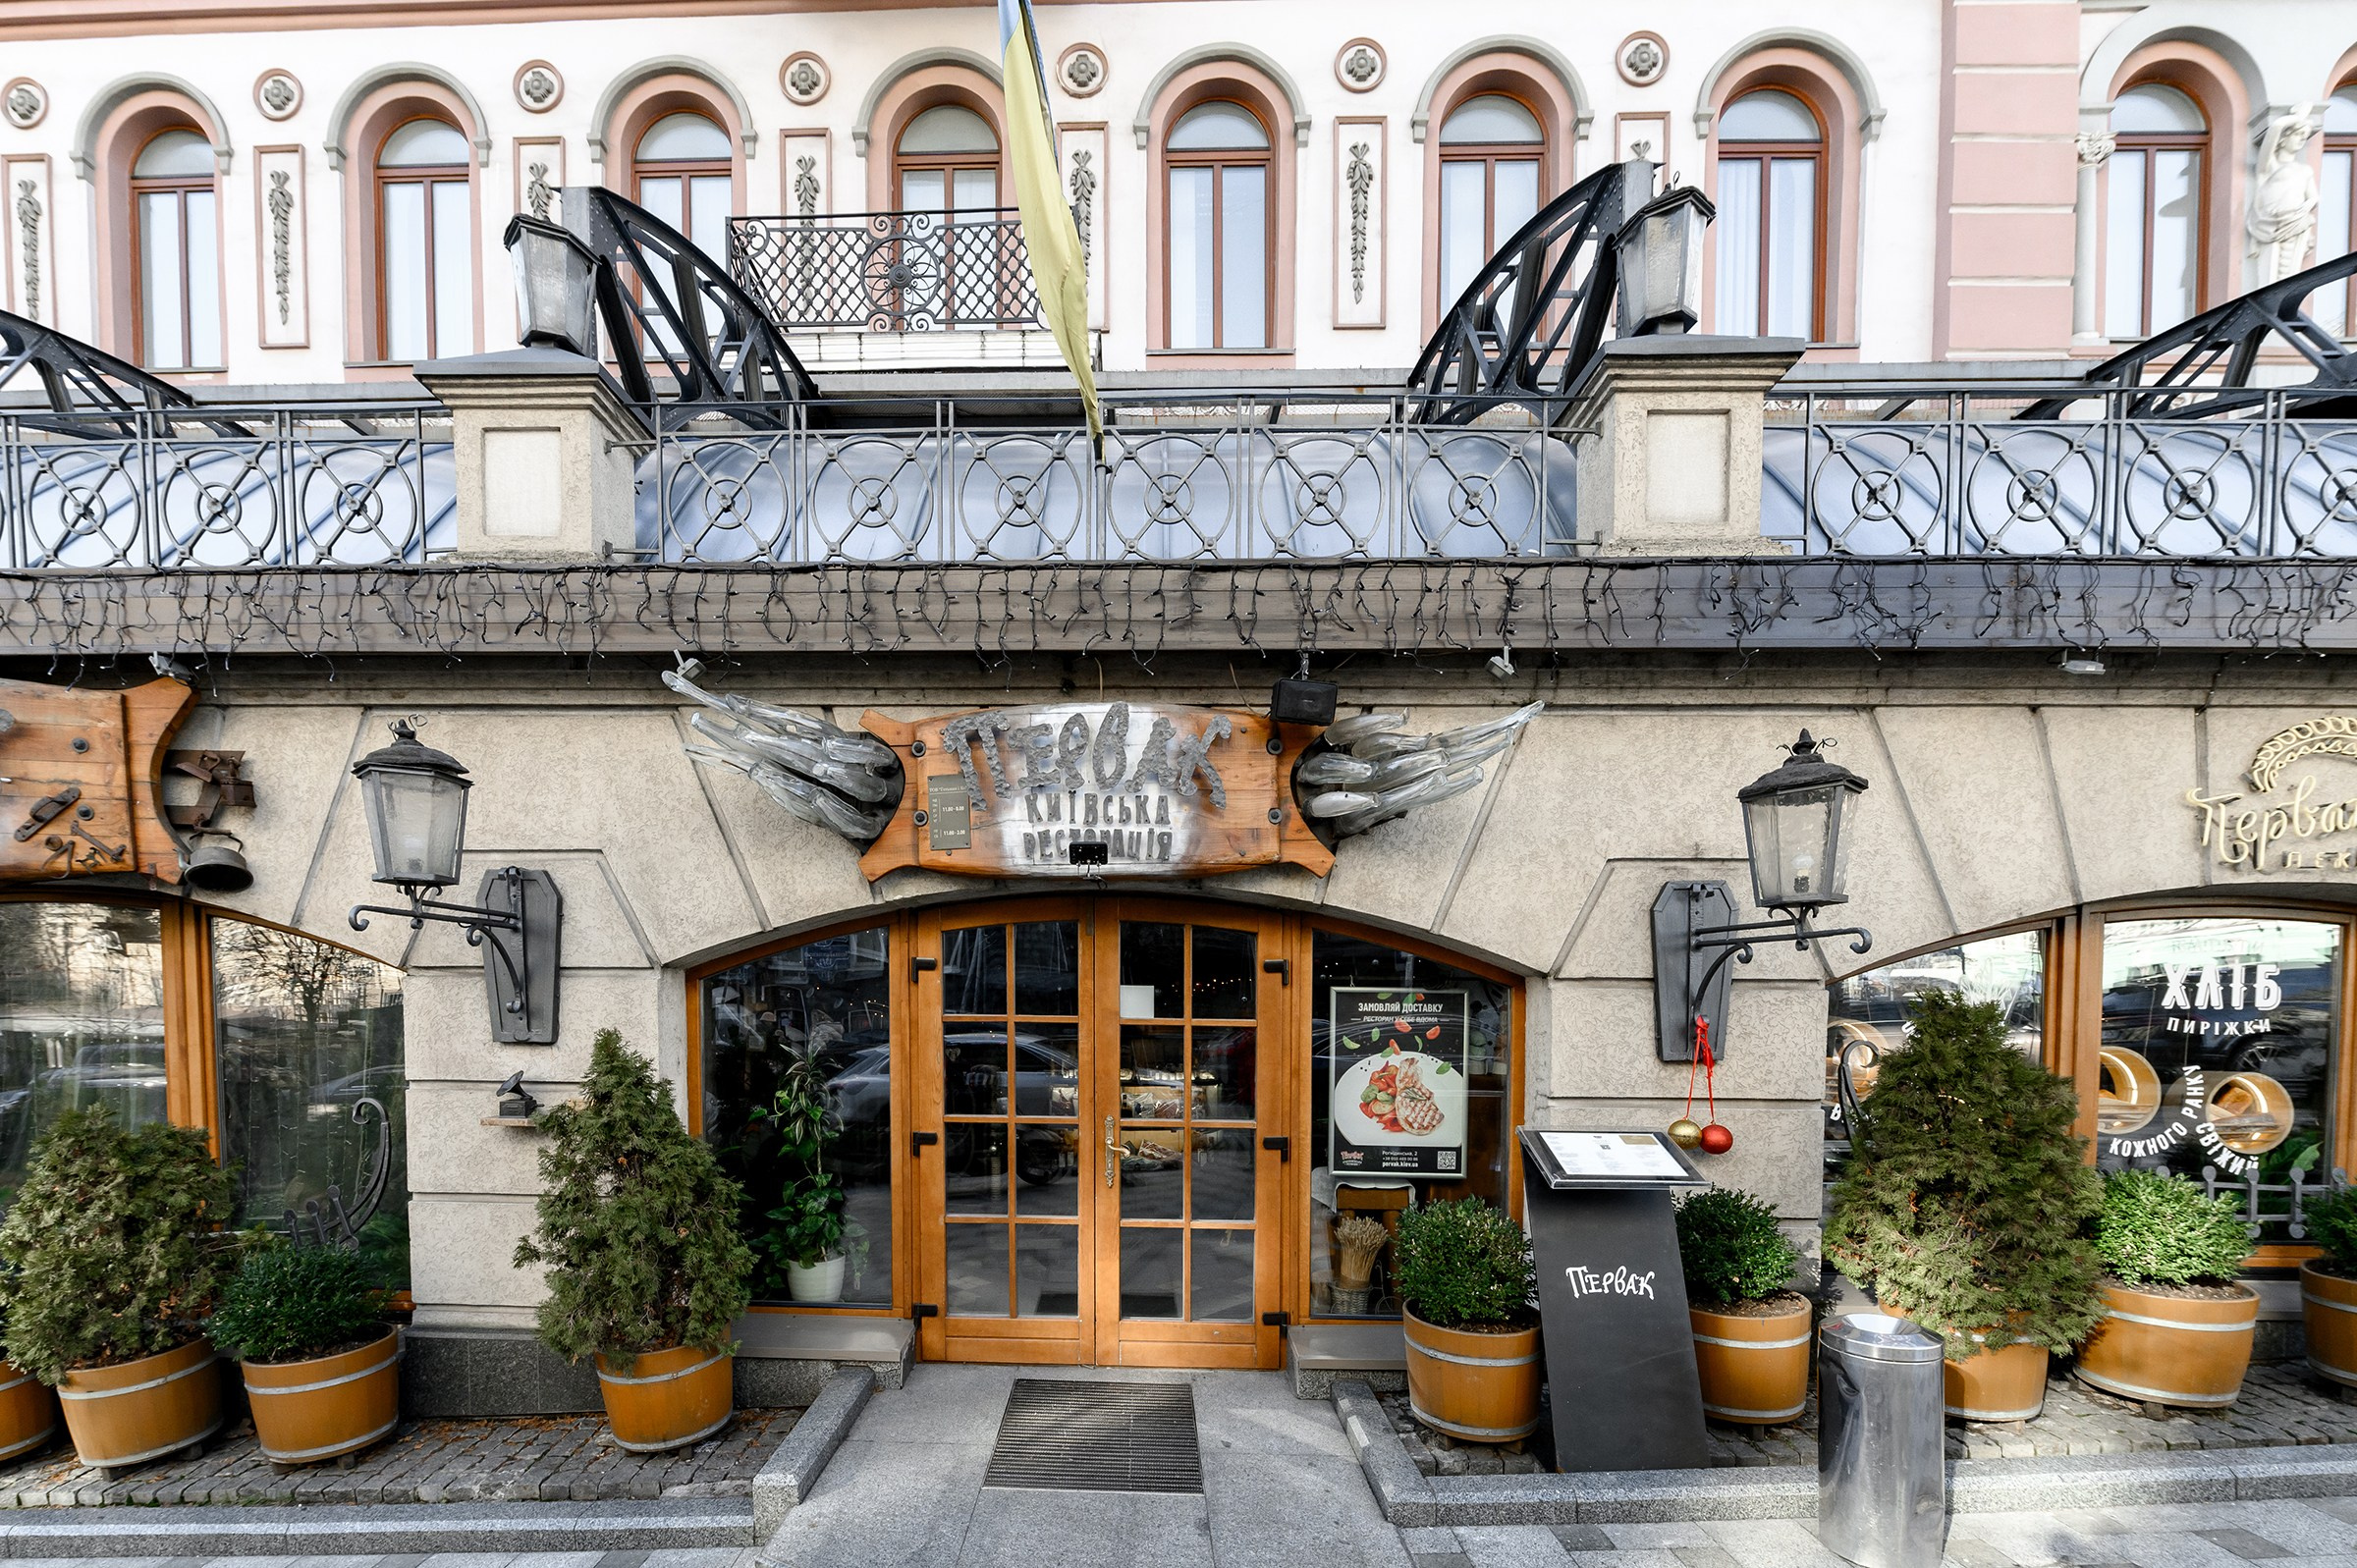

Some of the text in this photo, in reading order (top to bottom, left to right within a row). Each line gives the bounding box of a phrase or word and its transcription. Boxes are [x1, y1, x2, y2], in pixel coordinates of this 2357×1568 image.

[1024, 790, 1171, 825] КИЇВСЬКА
[2161, 962, 2282, 1010] ХЛІБ
[1358, 1001, 1444, 1013] ЗАМОВЛЯЙ ДОСТАВКУ
[2166, 1017, 2271, 1036] ПИРІЖКИ
[2109, 1064, 2205, 1158] КОЖНОГО РАНКУ
[2195, 1121, 2259, 1177] СВІЖИЙ
